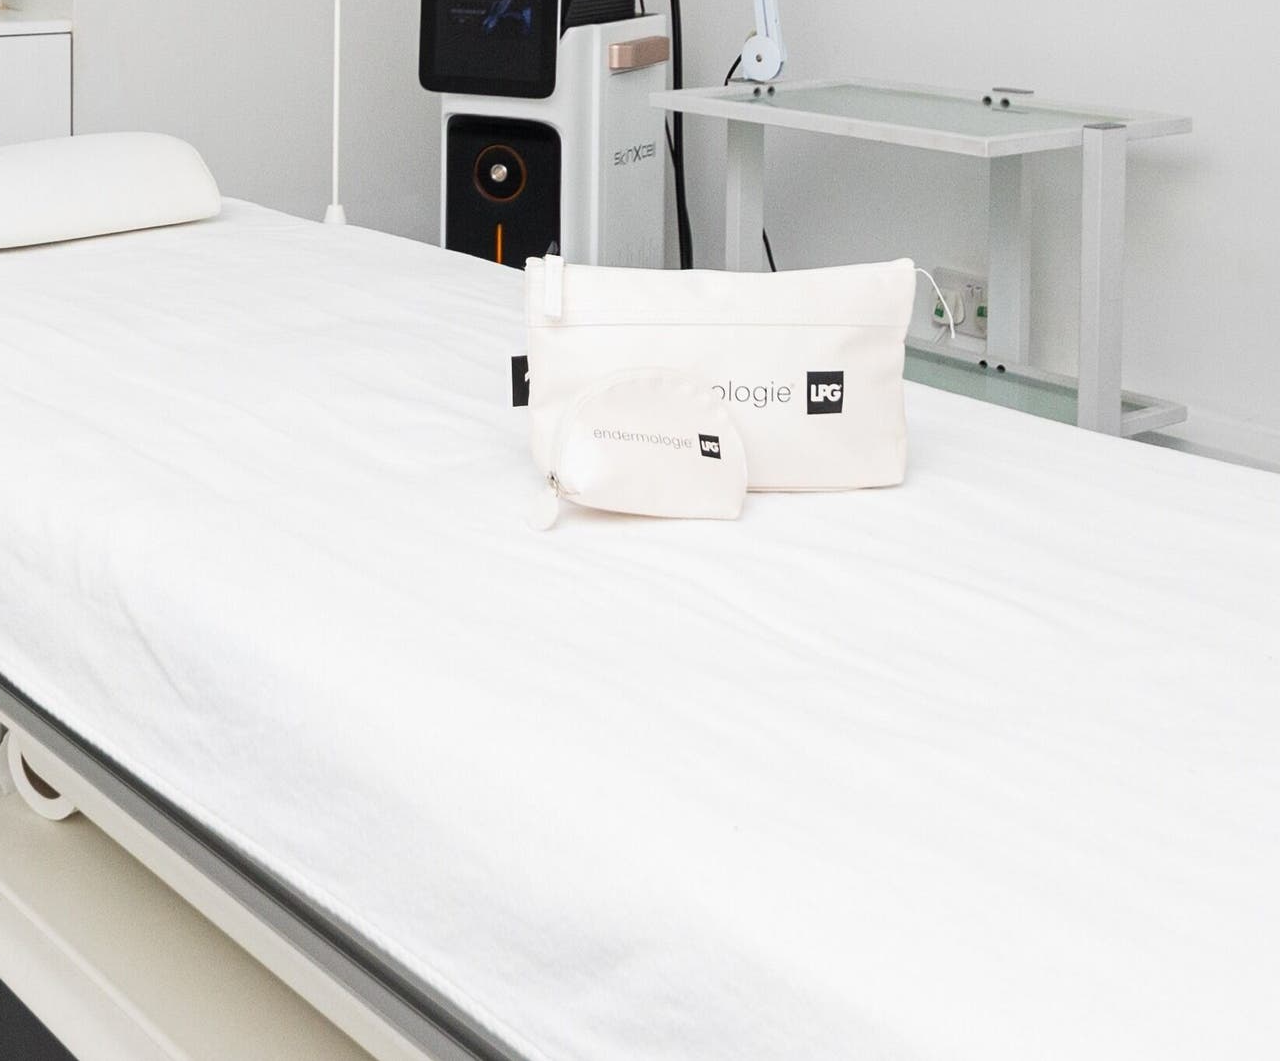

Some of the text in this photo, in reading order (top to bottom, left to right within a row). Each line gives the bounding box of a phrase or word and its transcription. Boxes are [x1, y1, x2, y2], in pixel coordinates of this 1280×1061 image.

[712, 380, 843, 408] ologie LPG
[593, 426, 720, 453] endermologie LPG
